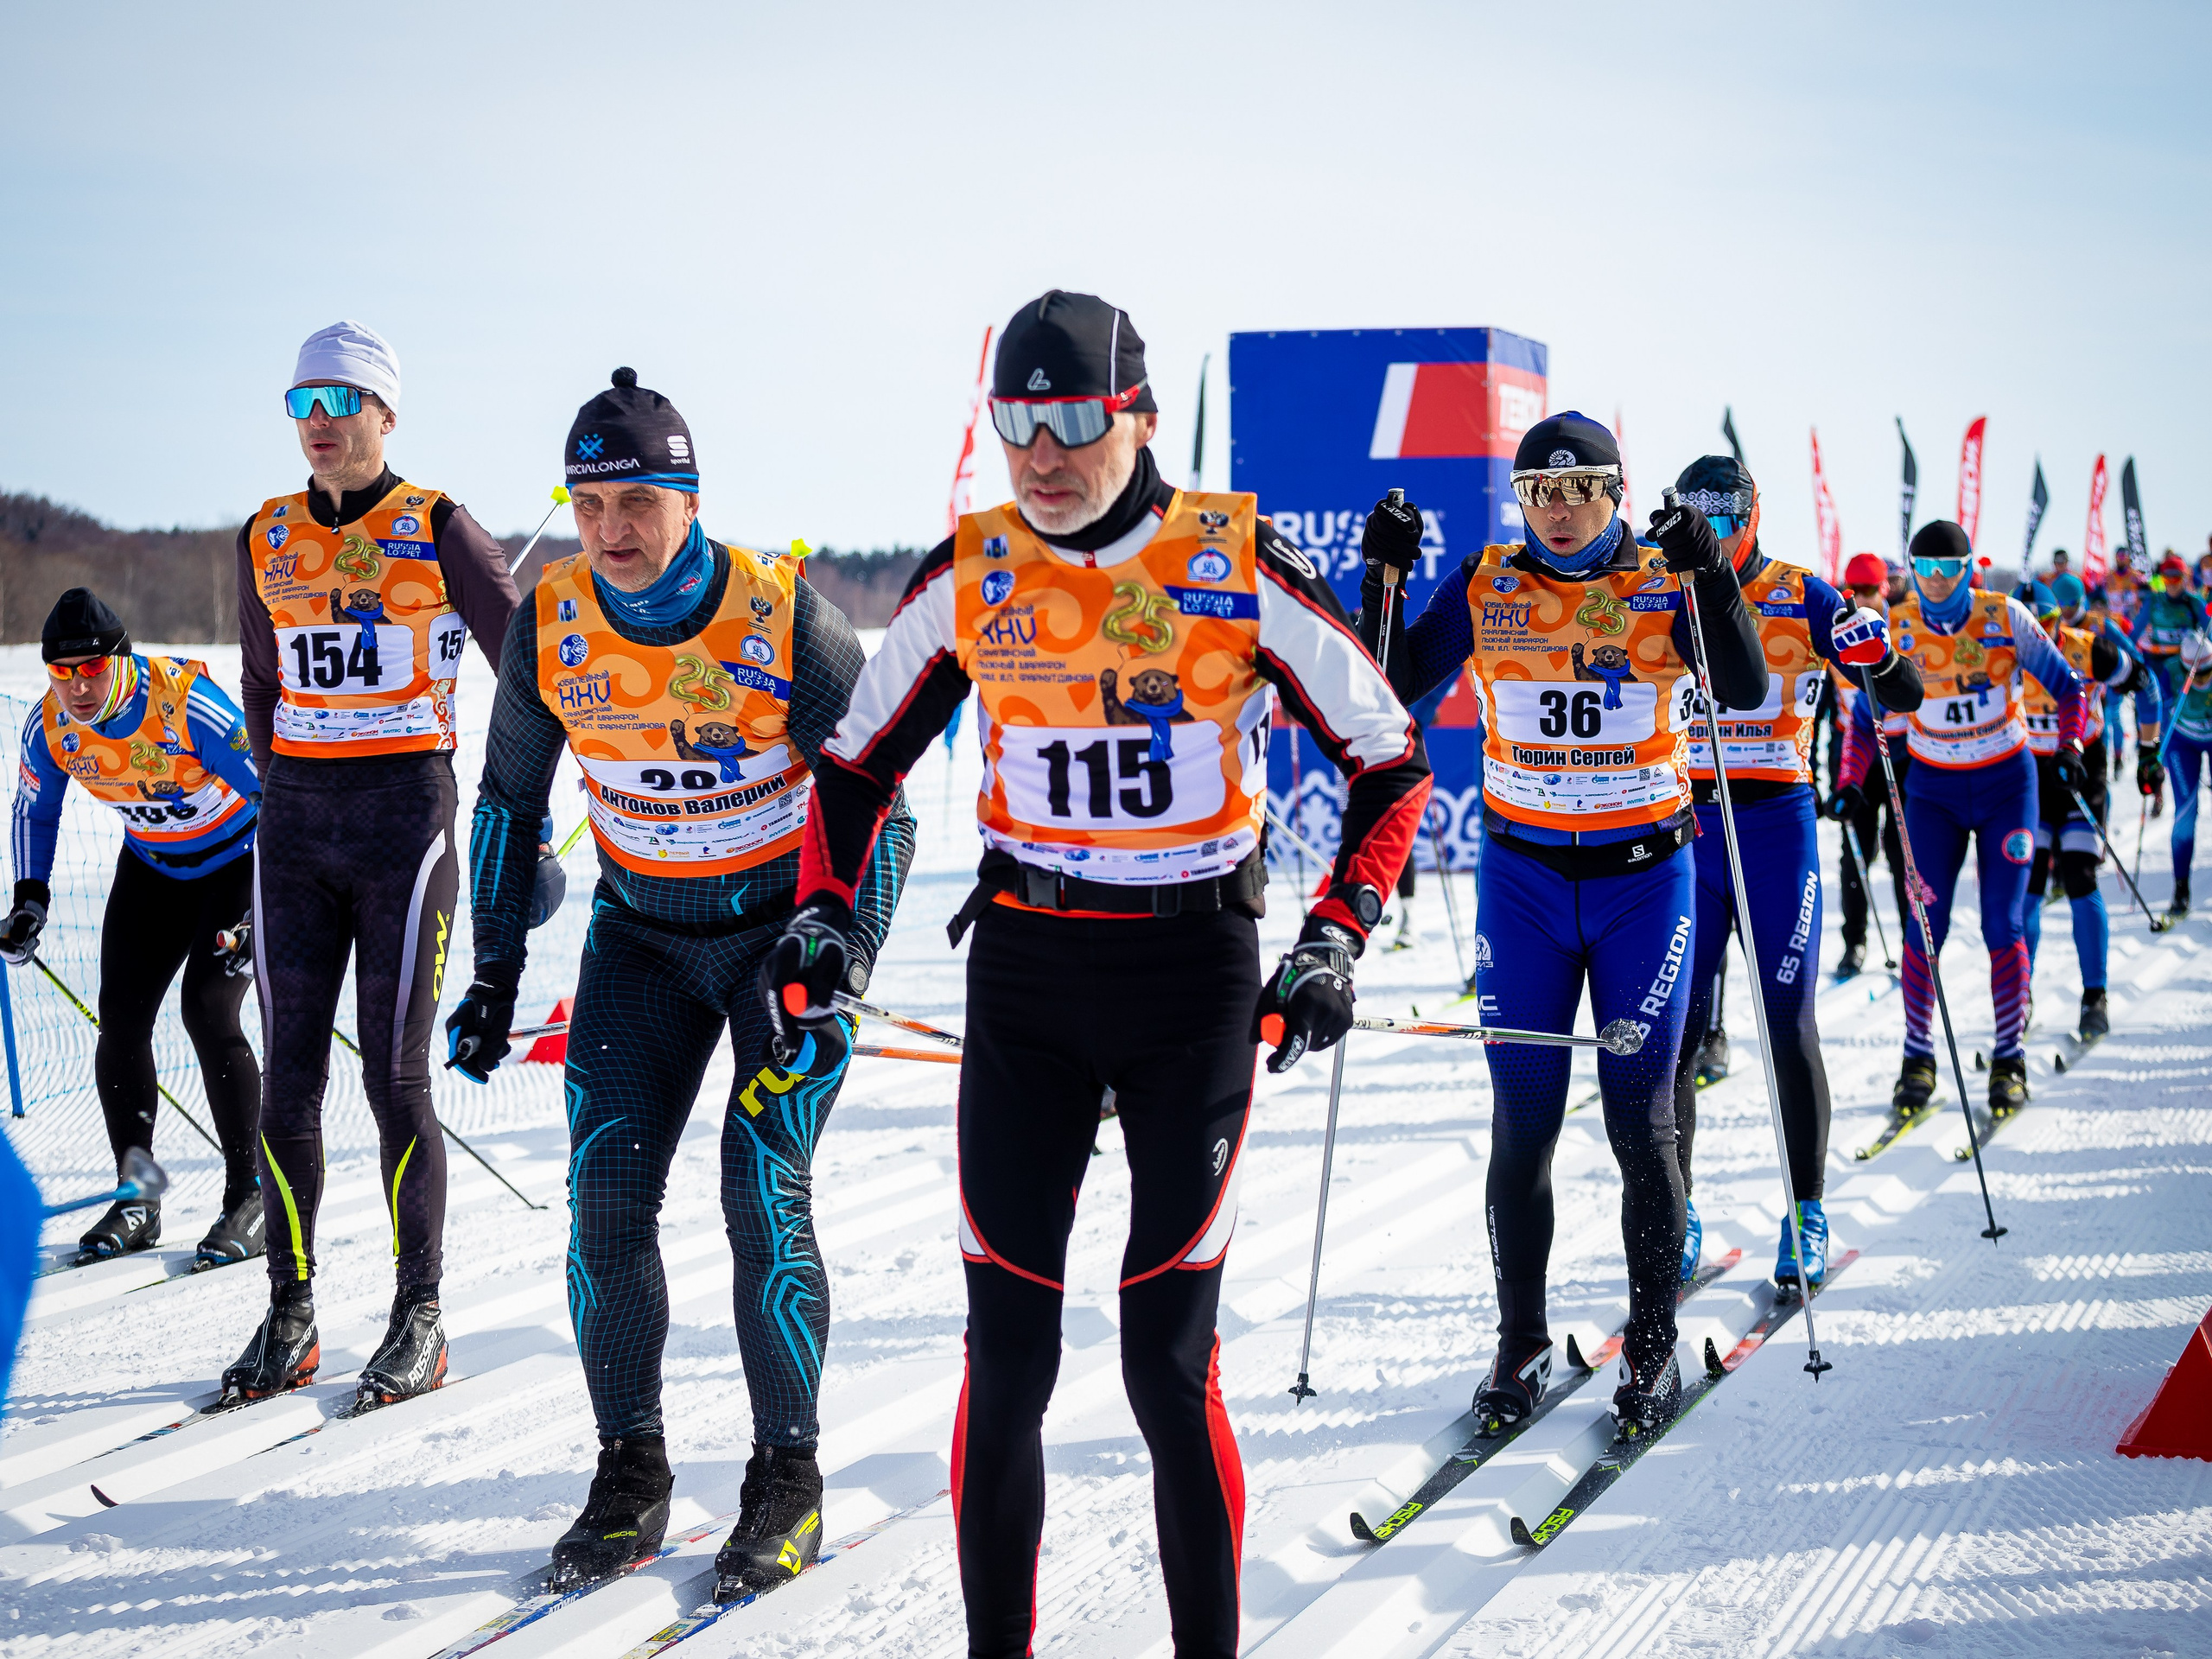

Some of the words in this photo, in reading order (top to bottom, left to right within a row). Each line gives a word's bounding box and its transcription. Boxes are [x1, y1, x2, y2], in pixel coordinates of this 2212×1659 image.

[1271, 510, 1446, 547] RUSA
[290, 632, 383, 689] 154
[1539, 690, 1602, 739] 36
[1736, 723, 1772, 738] Илья
[1946, 700, 1976, 725] 41
[1037, 739, 1174, 818] 115
[1512, 747, 1567, 766] Тюрин
[1570, 746, 1635, 766] Сергей
[1777, 954, 1801, 985] 65
[1789, 870, 1819, 951] REGION
[1639, 915, 1692, 1017] REGION
[1489, 1205, 1500, 1262] VICTORY
[603, 1530, 638, 1540] FISCHER
